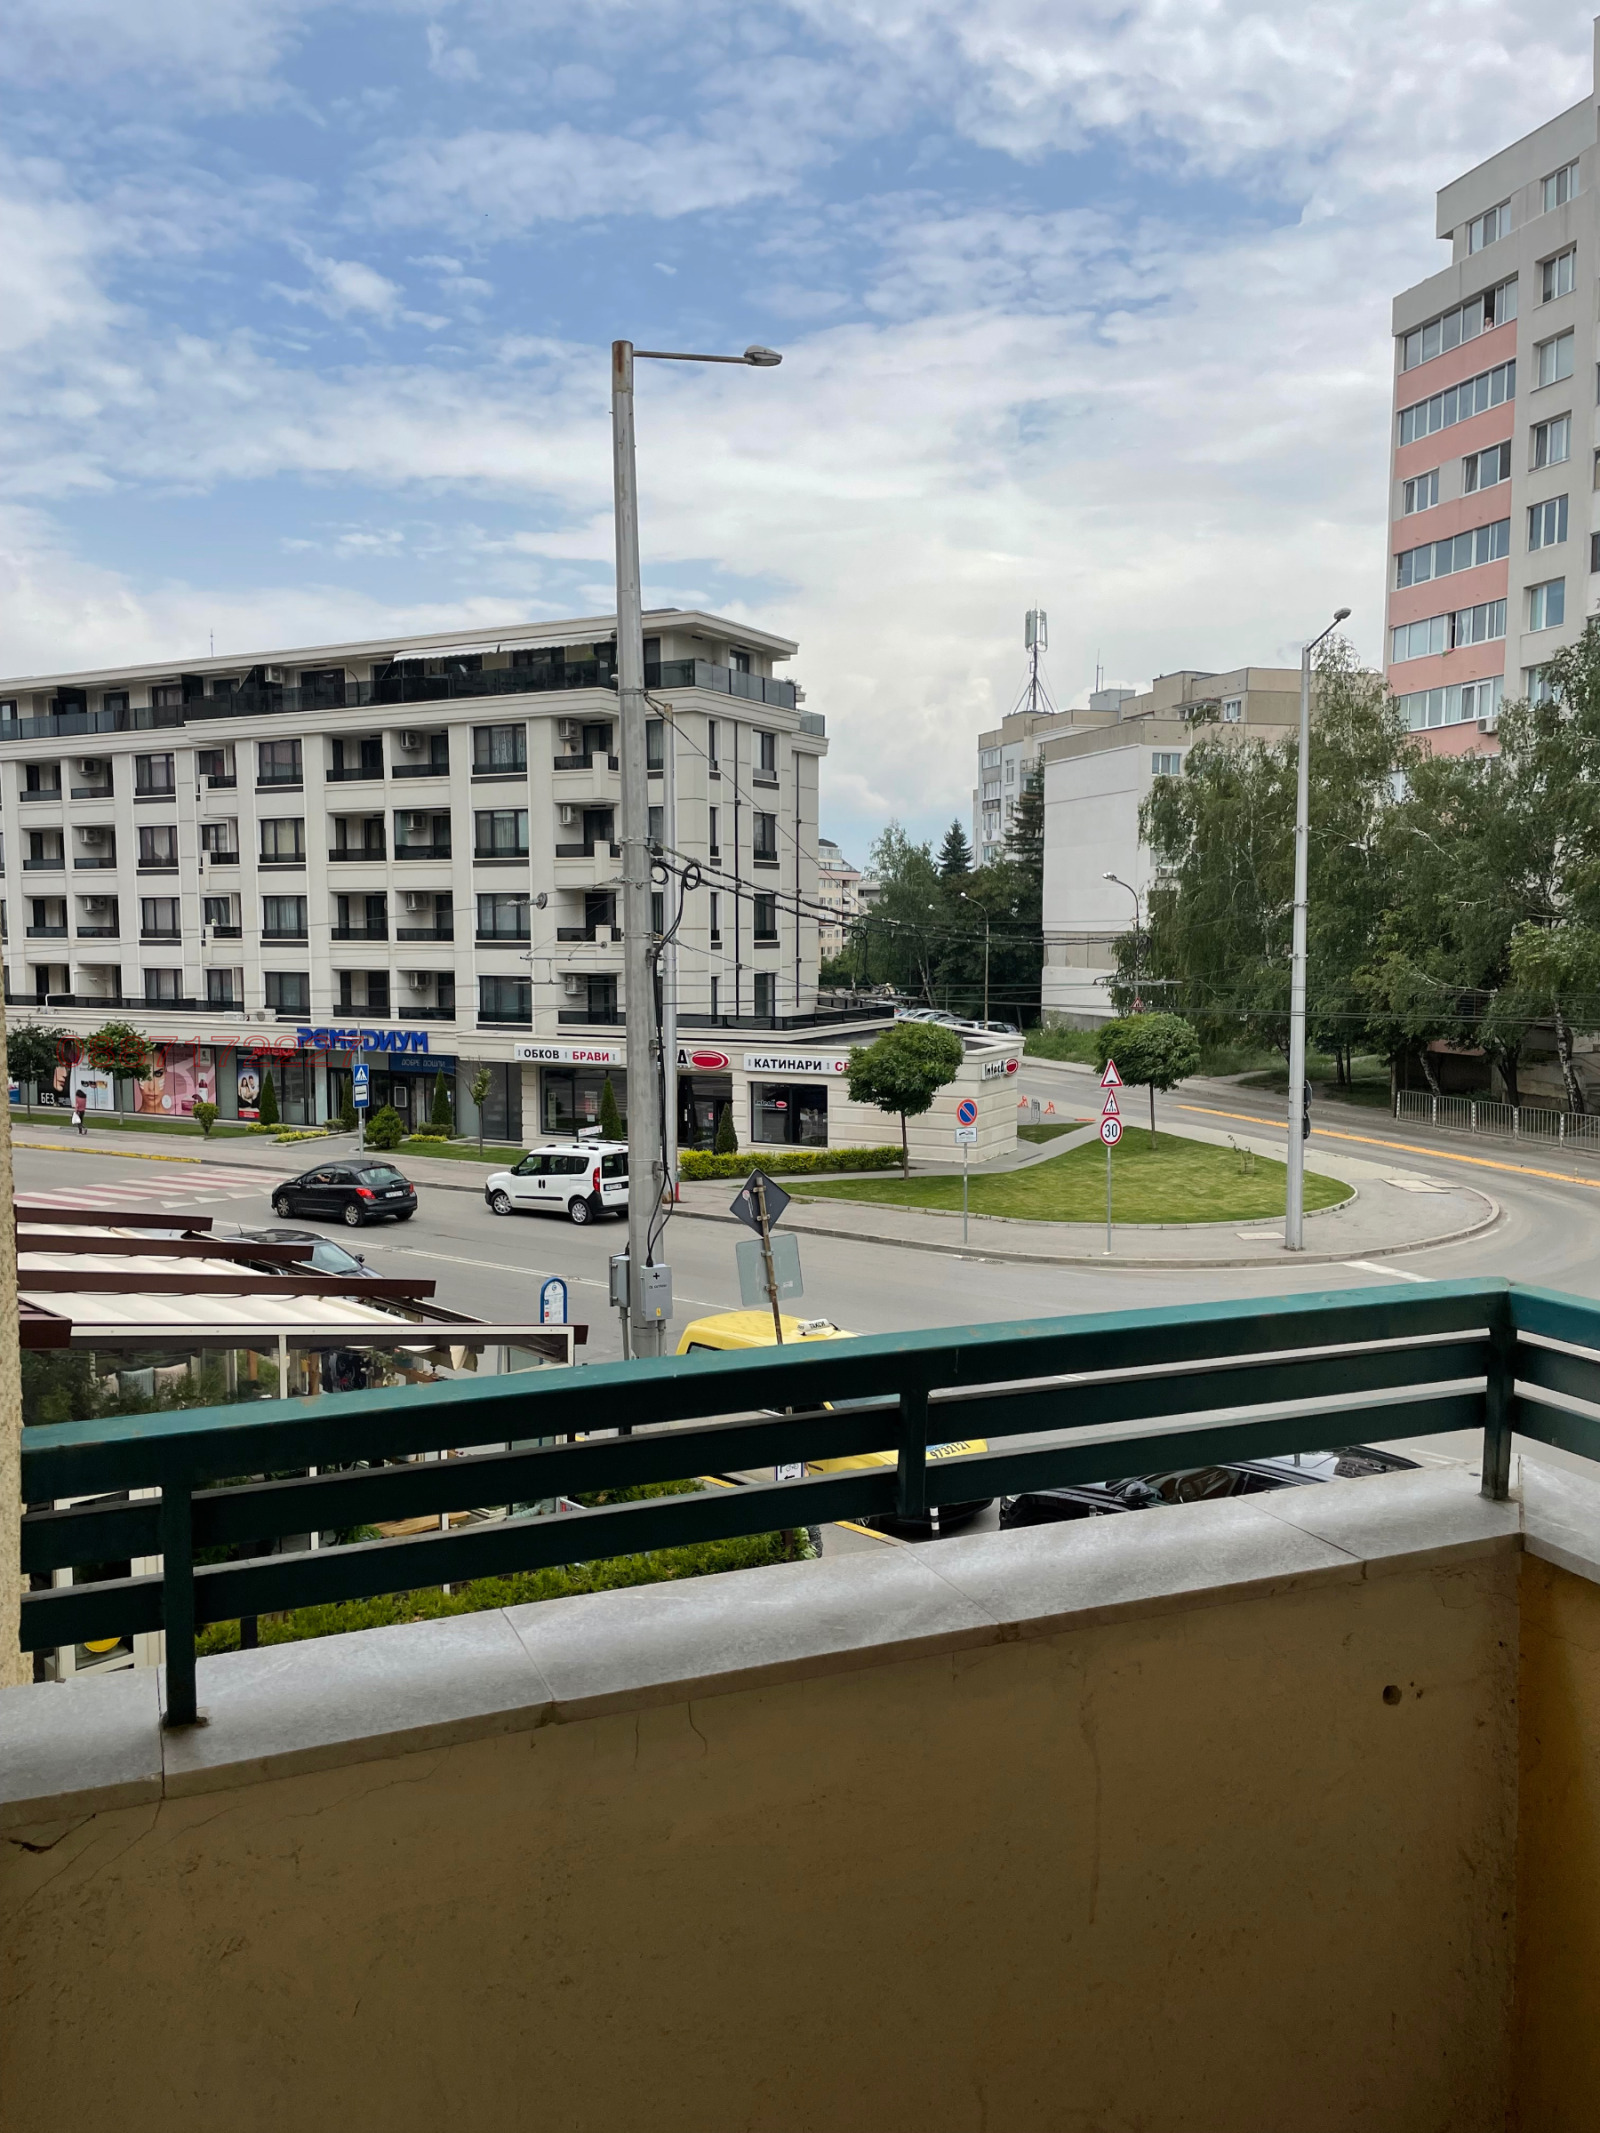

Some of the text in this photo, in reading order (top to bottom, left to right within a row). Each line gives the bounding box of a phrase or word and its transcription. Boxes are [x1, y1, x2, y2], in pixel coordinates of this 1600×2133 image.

[524, 1048, 610, 1061] ОБКОВ БРАВИ
[754, 1058, 822, 1071] КАТИНАРИ
[40, 1092, 55, 1105] БЕЗ
[1104, 1123, 1118, 1139] 30
